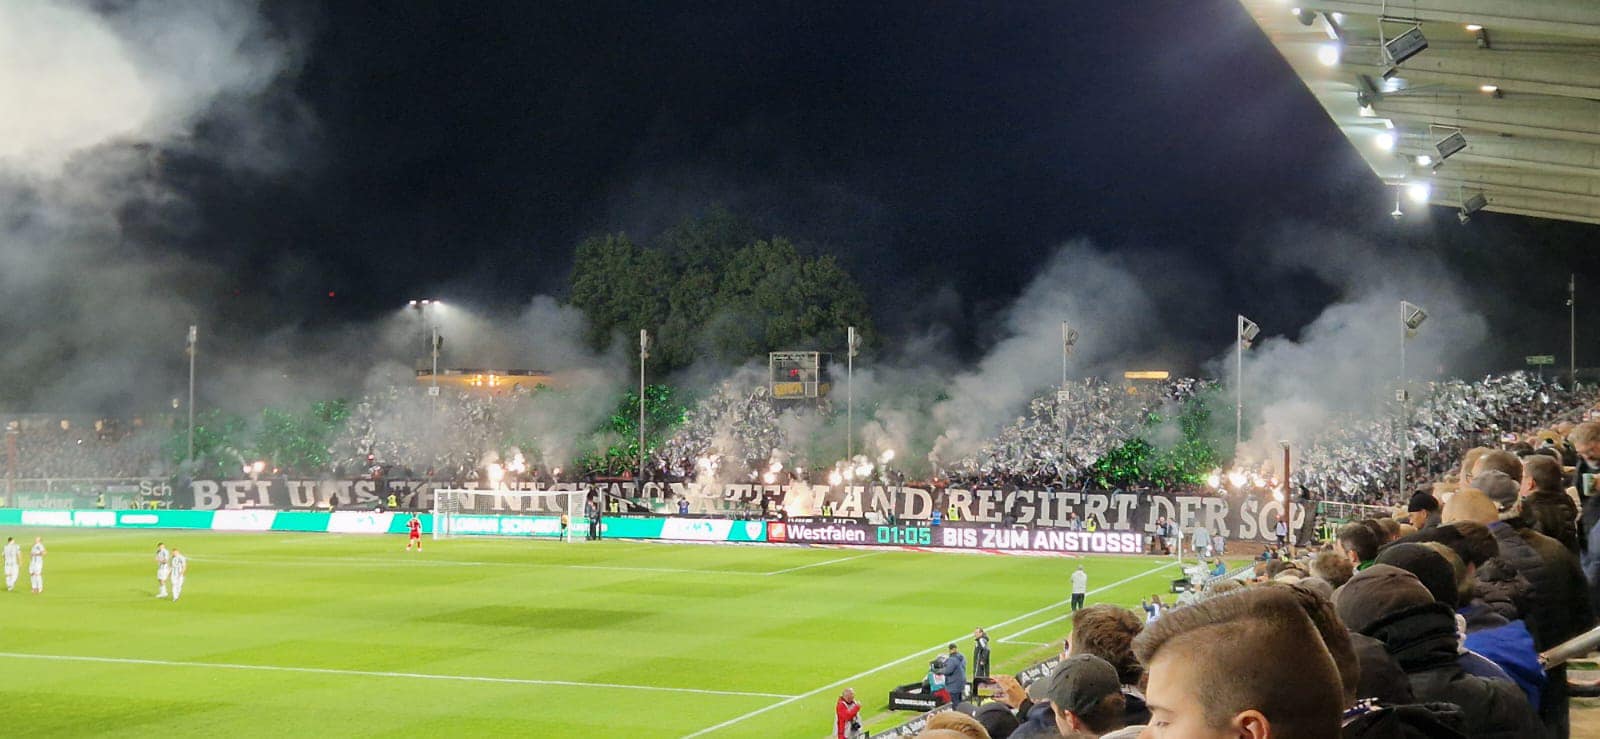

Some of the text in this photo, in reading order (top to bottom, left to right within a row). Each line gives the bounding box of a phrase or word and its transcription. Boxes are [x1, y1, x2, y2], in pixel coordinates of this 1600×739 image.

[190, 479, 274, 510] BEI
[286, 480, 379, 509] UNS
[946, 487, 1138, 531] REGIERT
[1144, 494, 1230, 538] DER
[787, 525, 866, 542] Westfalen
[877, 525, 1143, 553] 01:05 BIS ZUM ANSTOSS!
